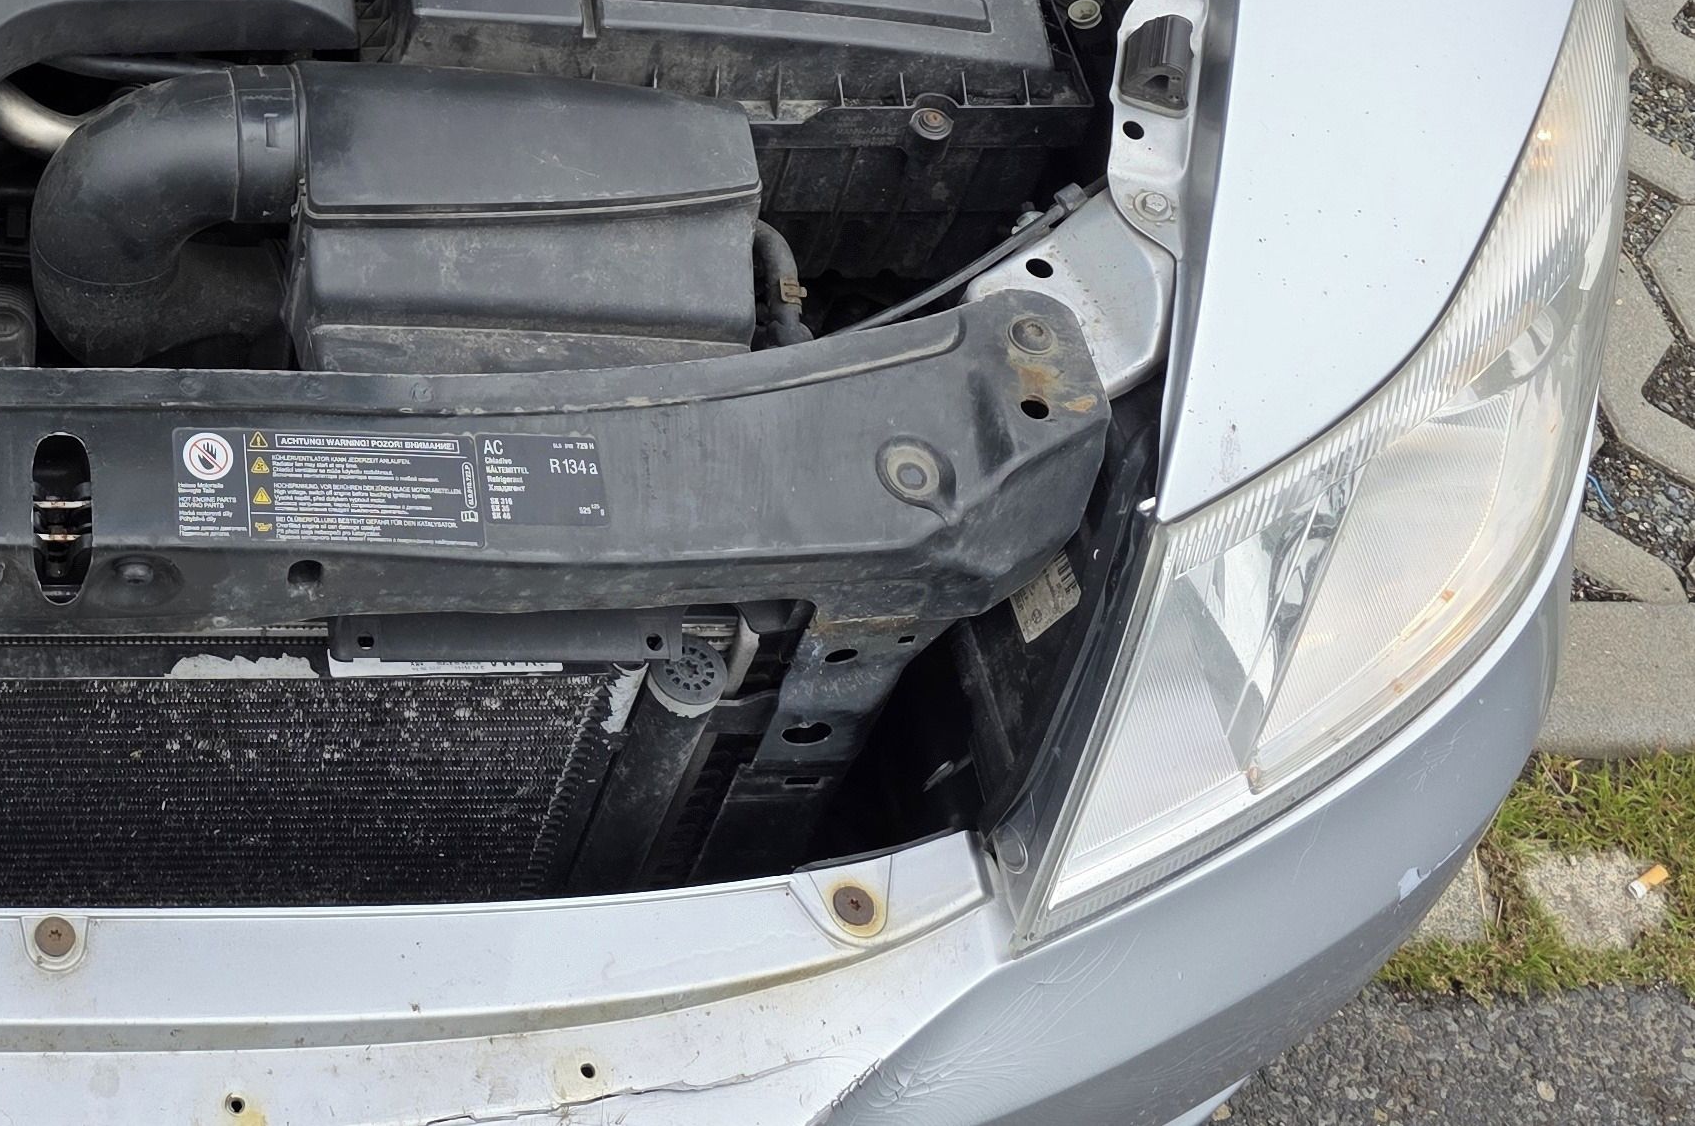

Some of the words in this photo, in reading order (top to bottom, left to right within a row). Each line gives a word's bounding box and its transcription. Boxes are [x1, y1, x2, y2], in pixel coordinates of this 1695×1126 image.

[281, 437, 325, 446] ACHTUNG!
[326, 438, 369, 447] WARNING!
[371, 440, 403, 448] POZOR!
[483, 439, 504, 455] AC
[549, 458, 562, 474] R
[562, 458, 587, 475] 134
[588, 462, 599, 475] a
[217, 496, 237, 504] PARTS
